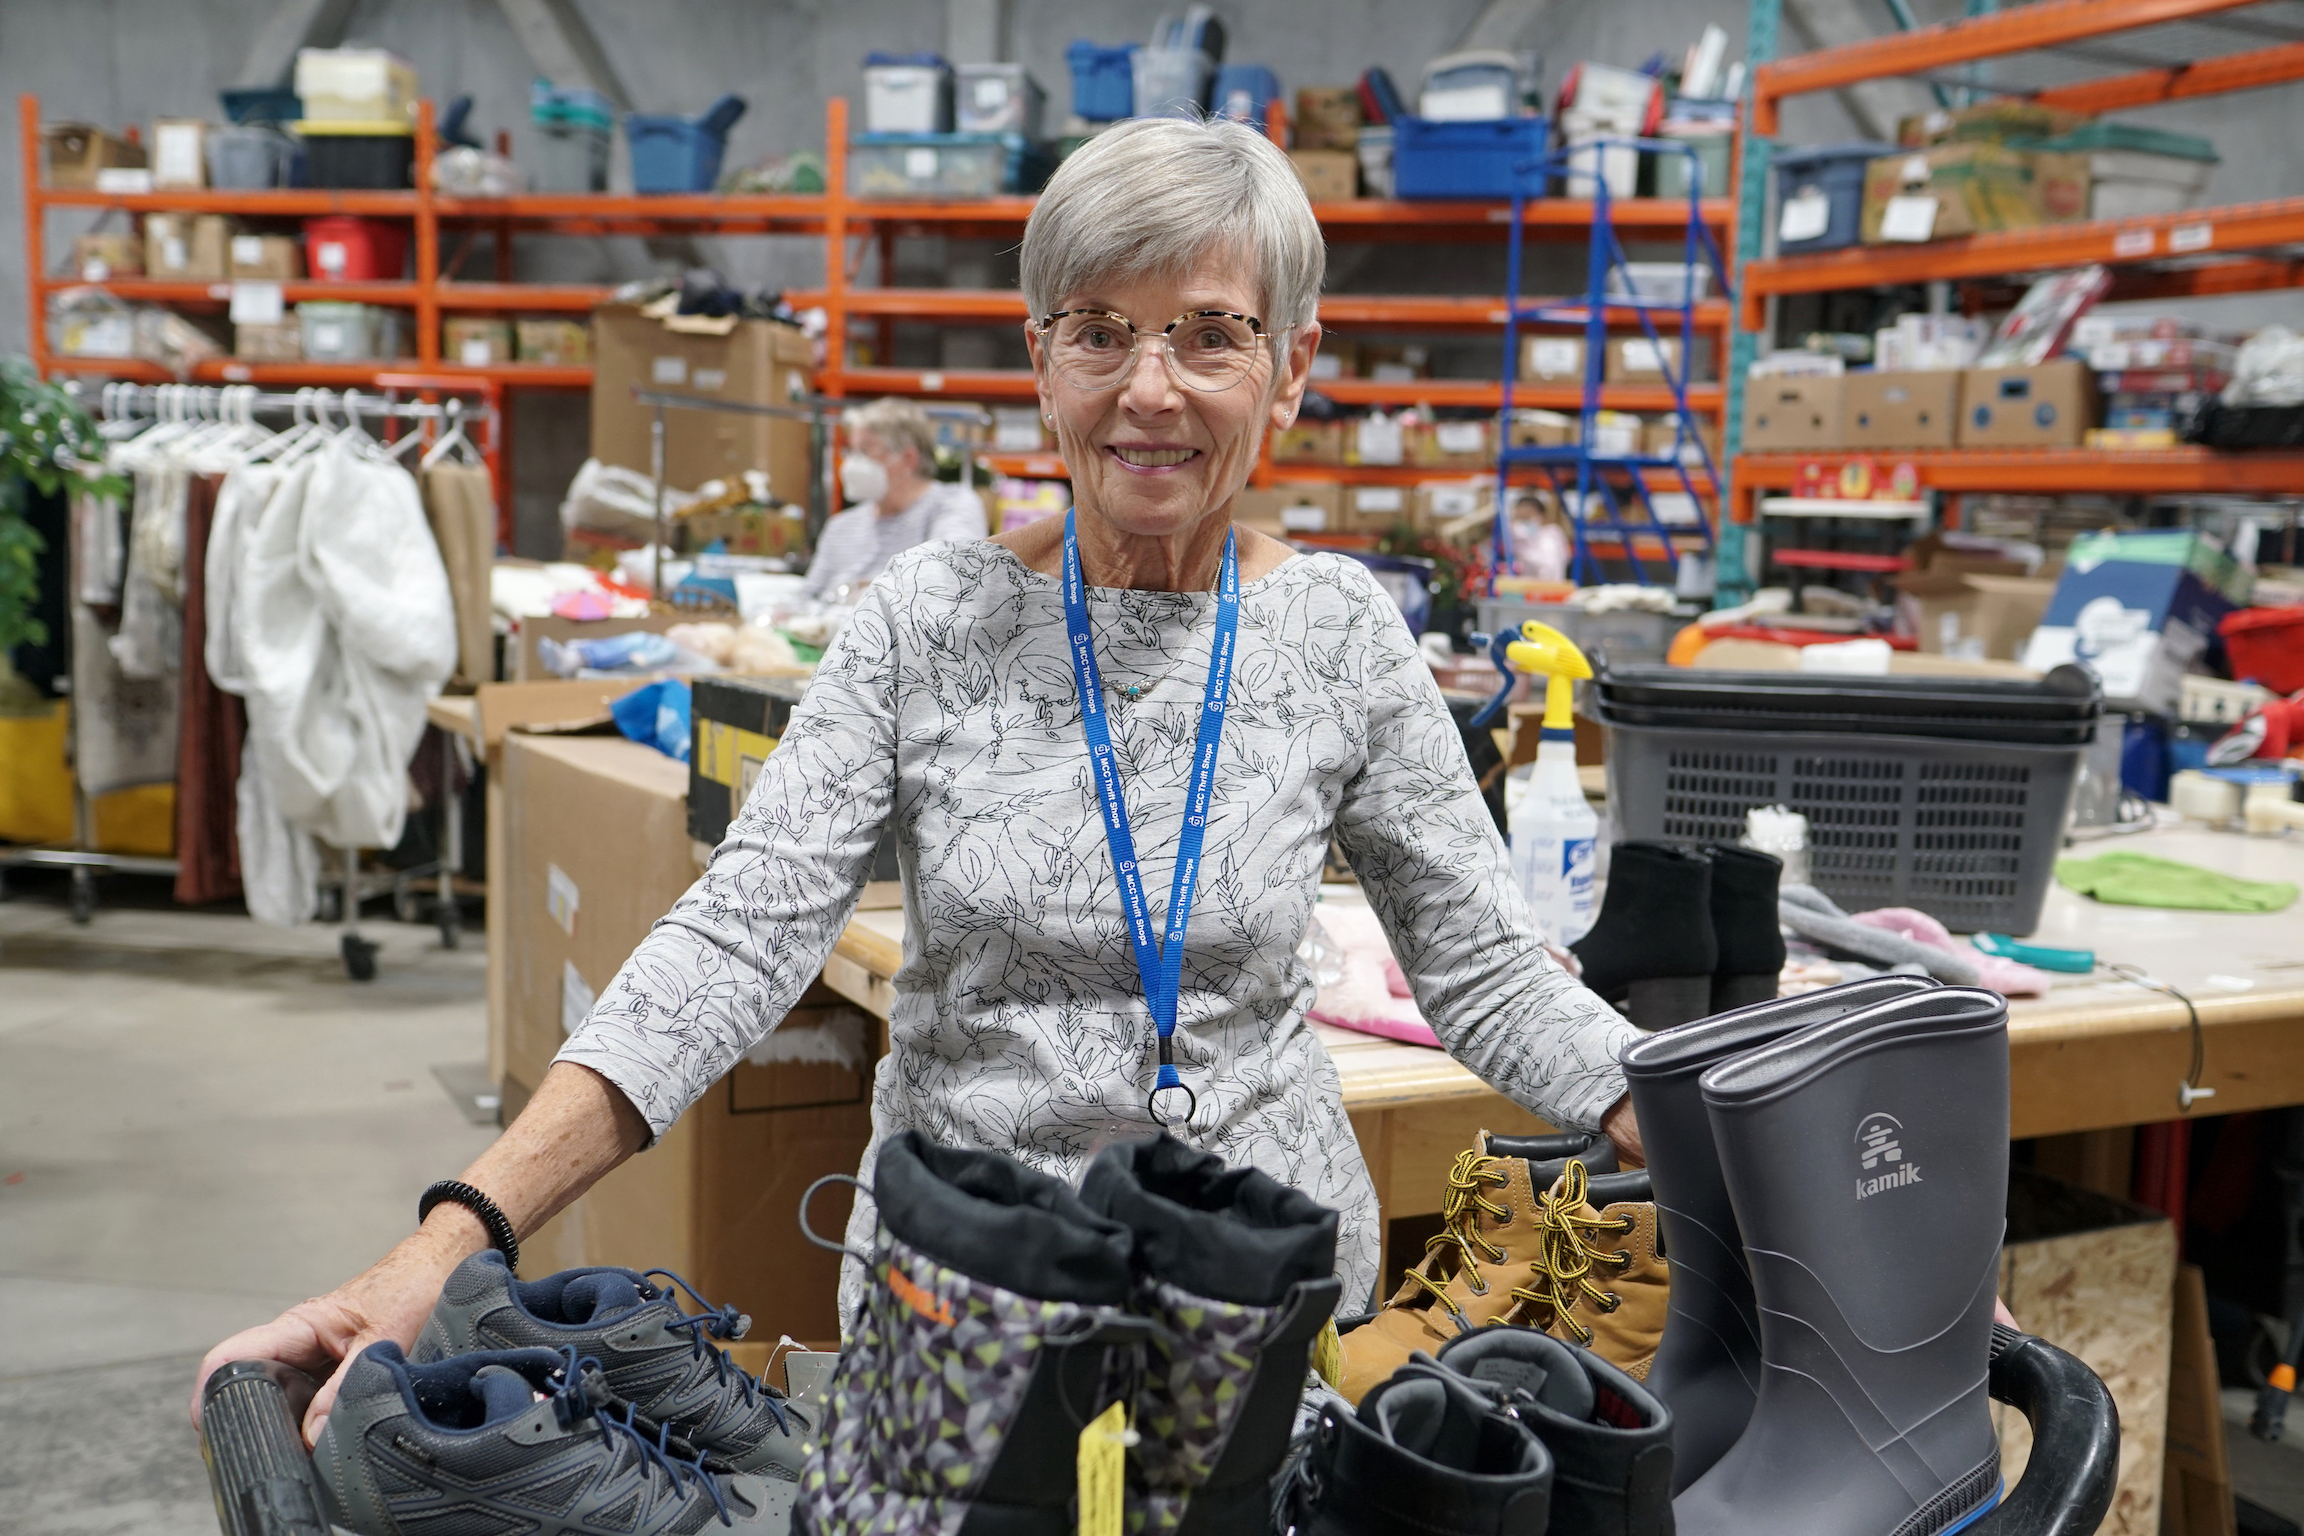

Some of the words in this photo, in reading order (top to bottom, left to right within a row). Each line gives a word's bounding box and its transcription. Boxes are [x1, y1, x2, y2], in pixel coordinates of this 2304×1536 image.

[1069, 564, 1077, 582] Thrift
[1221, 631, 1231, 657] Shops
[1079, 646, 1089, 666] MCC
[1083, 666, 1093, 688] Thrift
[1217, 657, 1226, 679] Thrift
[1214, 679, 1224, 699] MCC
[1086, 688, 1096, 715] Shops
[1100, 757, 1110, 778] MCC
[1202, 743, 1213, 770] Shops
[1104, 777, 1115, 802] Thrift
[1198, 770, 1208, 793] Thrift
[1195, 793, 1205, 813] MCC
[1109, 801, 1120, 829] Shops
[1182, 858, 1193, 885] Shops
[1126, 874, 1136, 894] MCC
[1130, 894, 1142, 918] Thrift
[1178, 886, 1188, 909] Thrift
[1175, 908, 1184, 928] MCC
[1136, 917, 1147, 947] Shops
[1856, 1162, 1923, 1200] kamik
